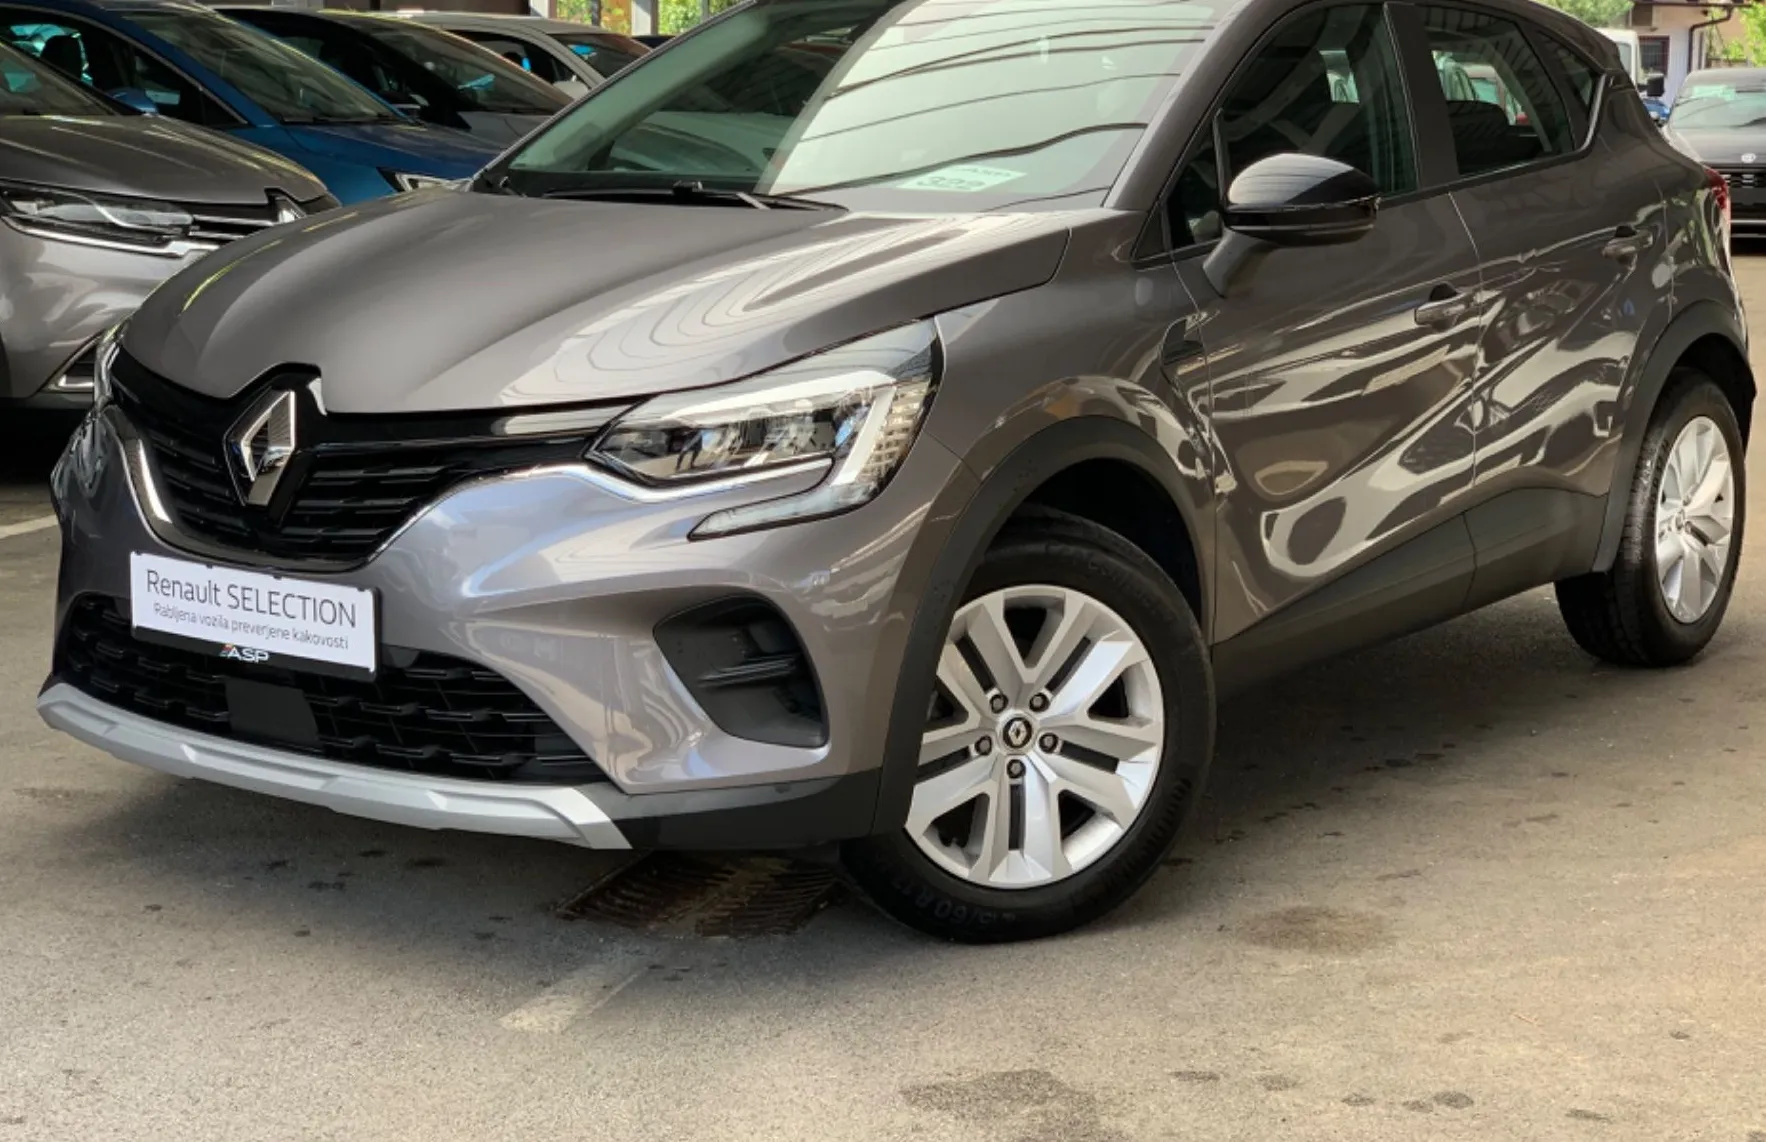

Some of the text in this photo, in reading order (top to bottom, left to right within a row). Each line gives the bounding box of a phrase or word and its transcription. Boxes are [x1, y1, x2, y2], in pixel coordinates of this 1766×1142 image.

[146, 569, 357, 628] Renault SELECTION
[153, 601, 349, 650] Rabljena vozila preverjene kakovosti
[226, 647, 269, 663] ASP
